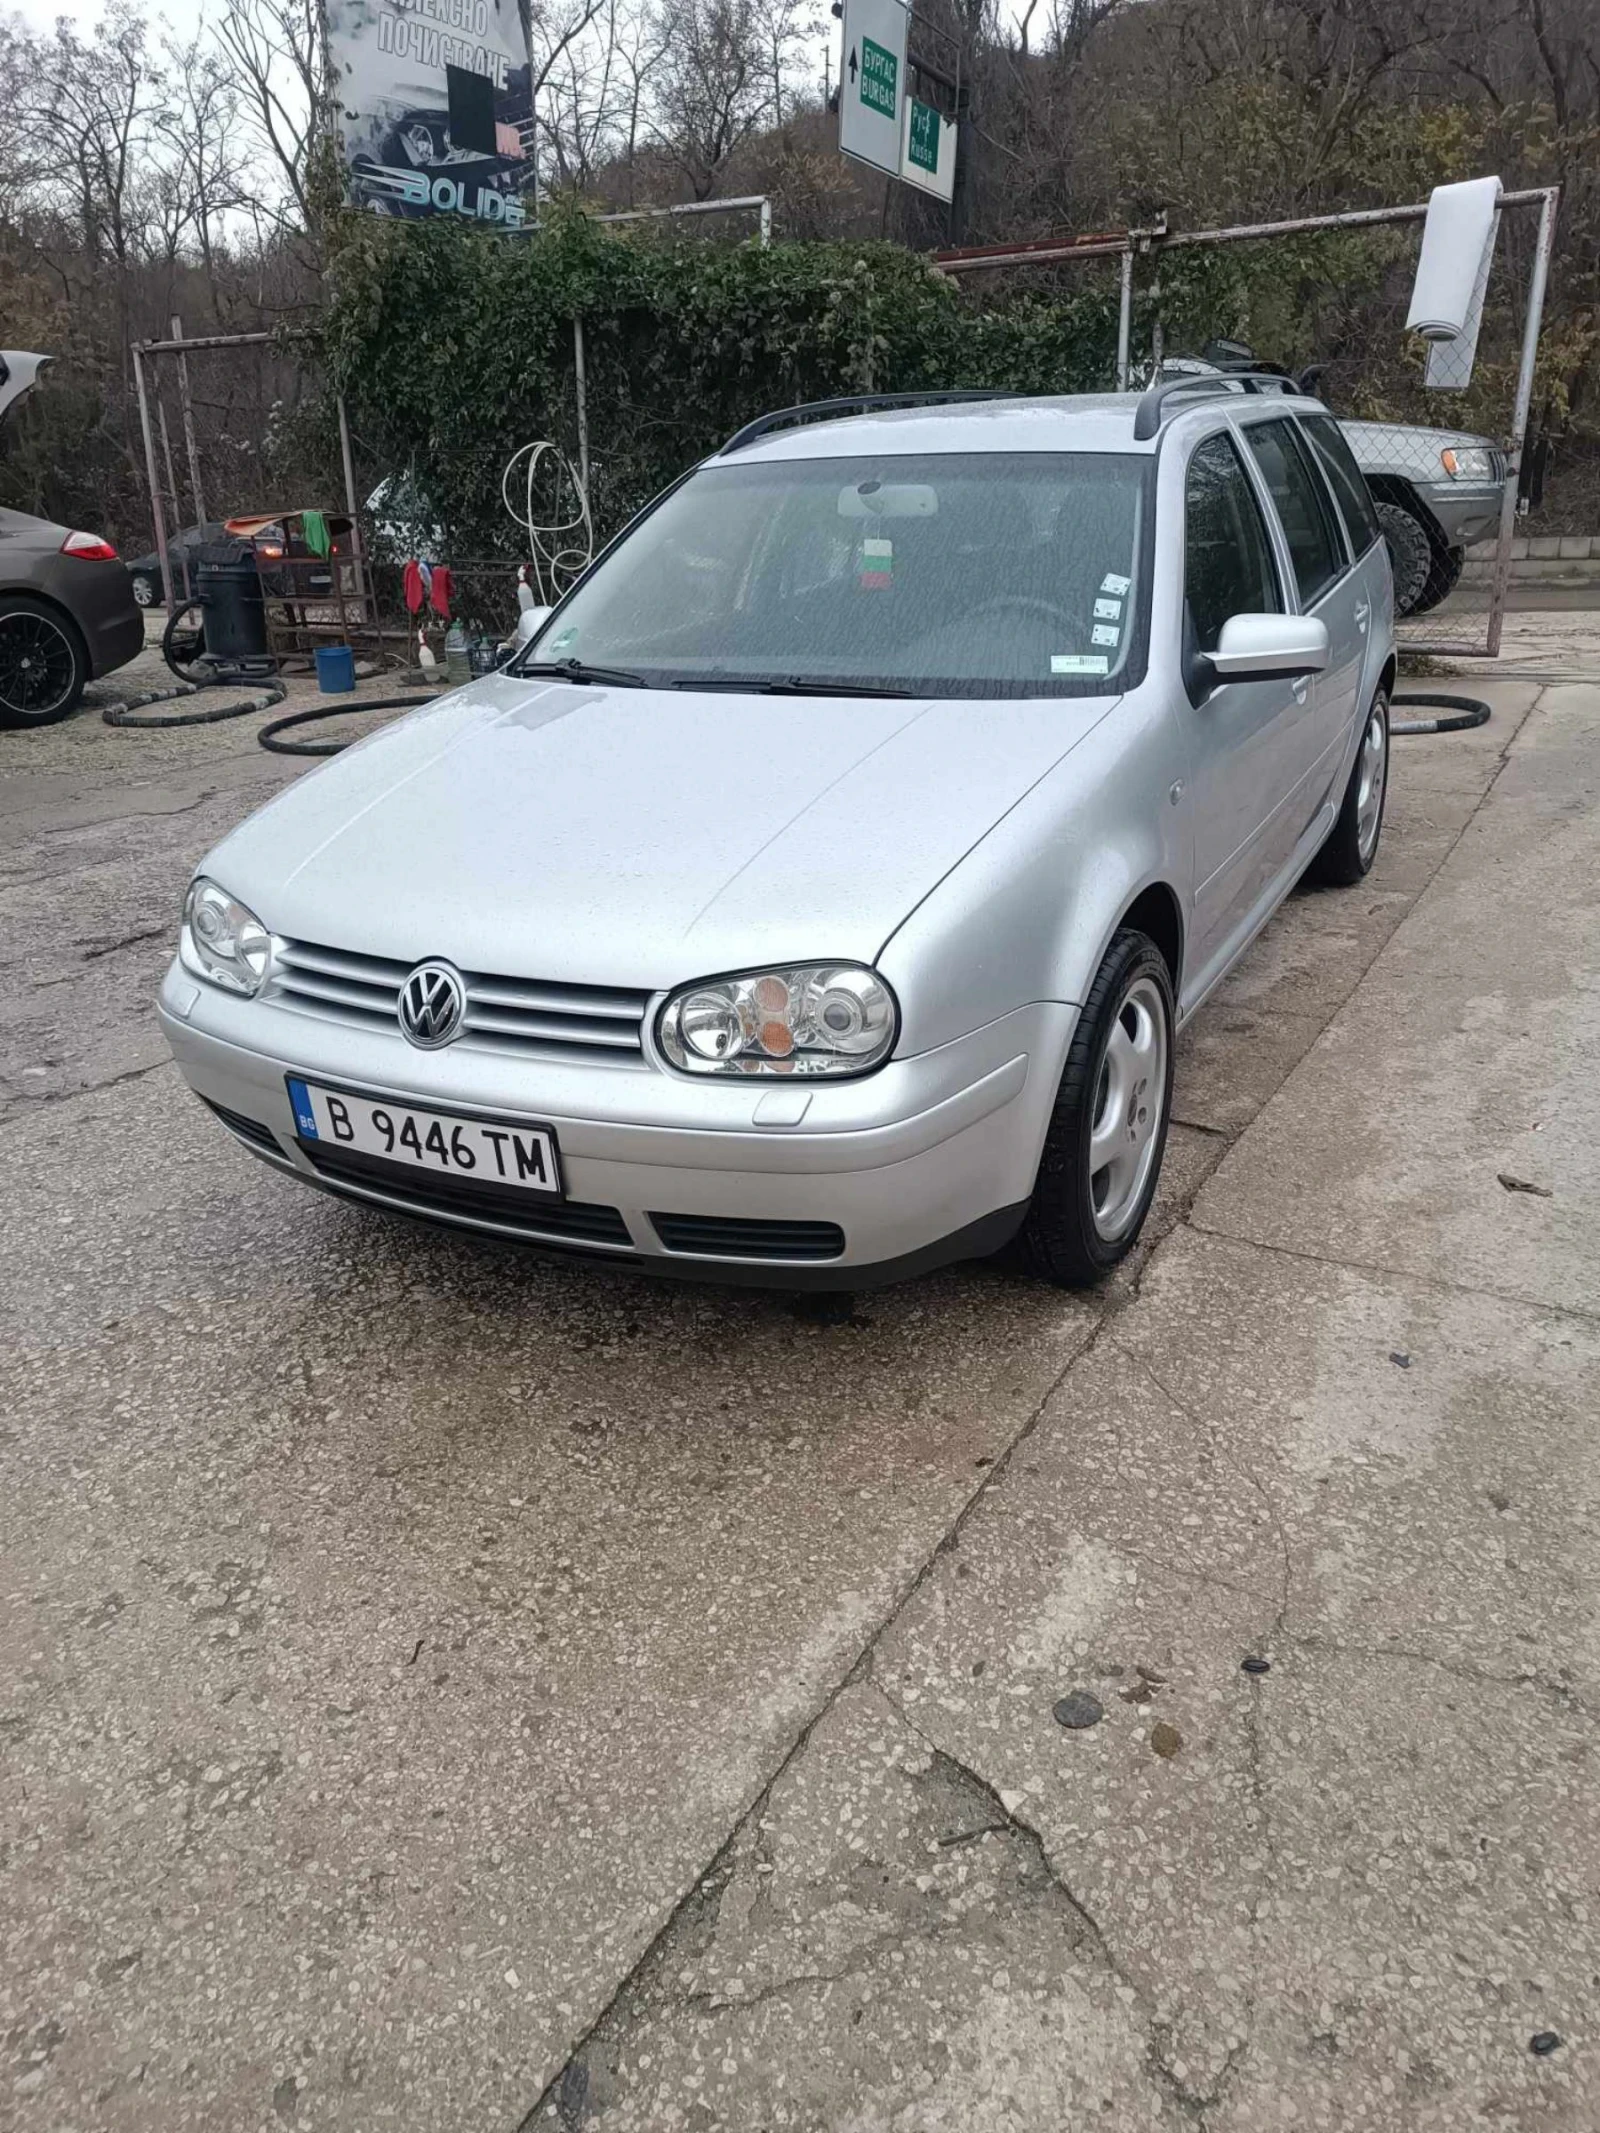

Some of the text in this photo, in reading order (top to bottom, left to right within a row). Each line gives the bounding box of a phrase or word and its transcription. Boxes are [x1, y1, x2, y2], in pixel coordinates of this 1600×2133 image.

[378, 11, 511, 91] ПОЧИСТВАНЕ
[864, 46, 895, 83] БУРГАС
[862, 74, 894, 111] BURGAS
[351, 162, 526, 226] BOLIDE
[298, 1114, 316, 1131] BG
[326, 1096, 547, 1184] B 9446 TM
